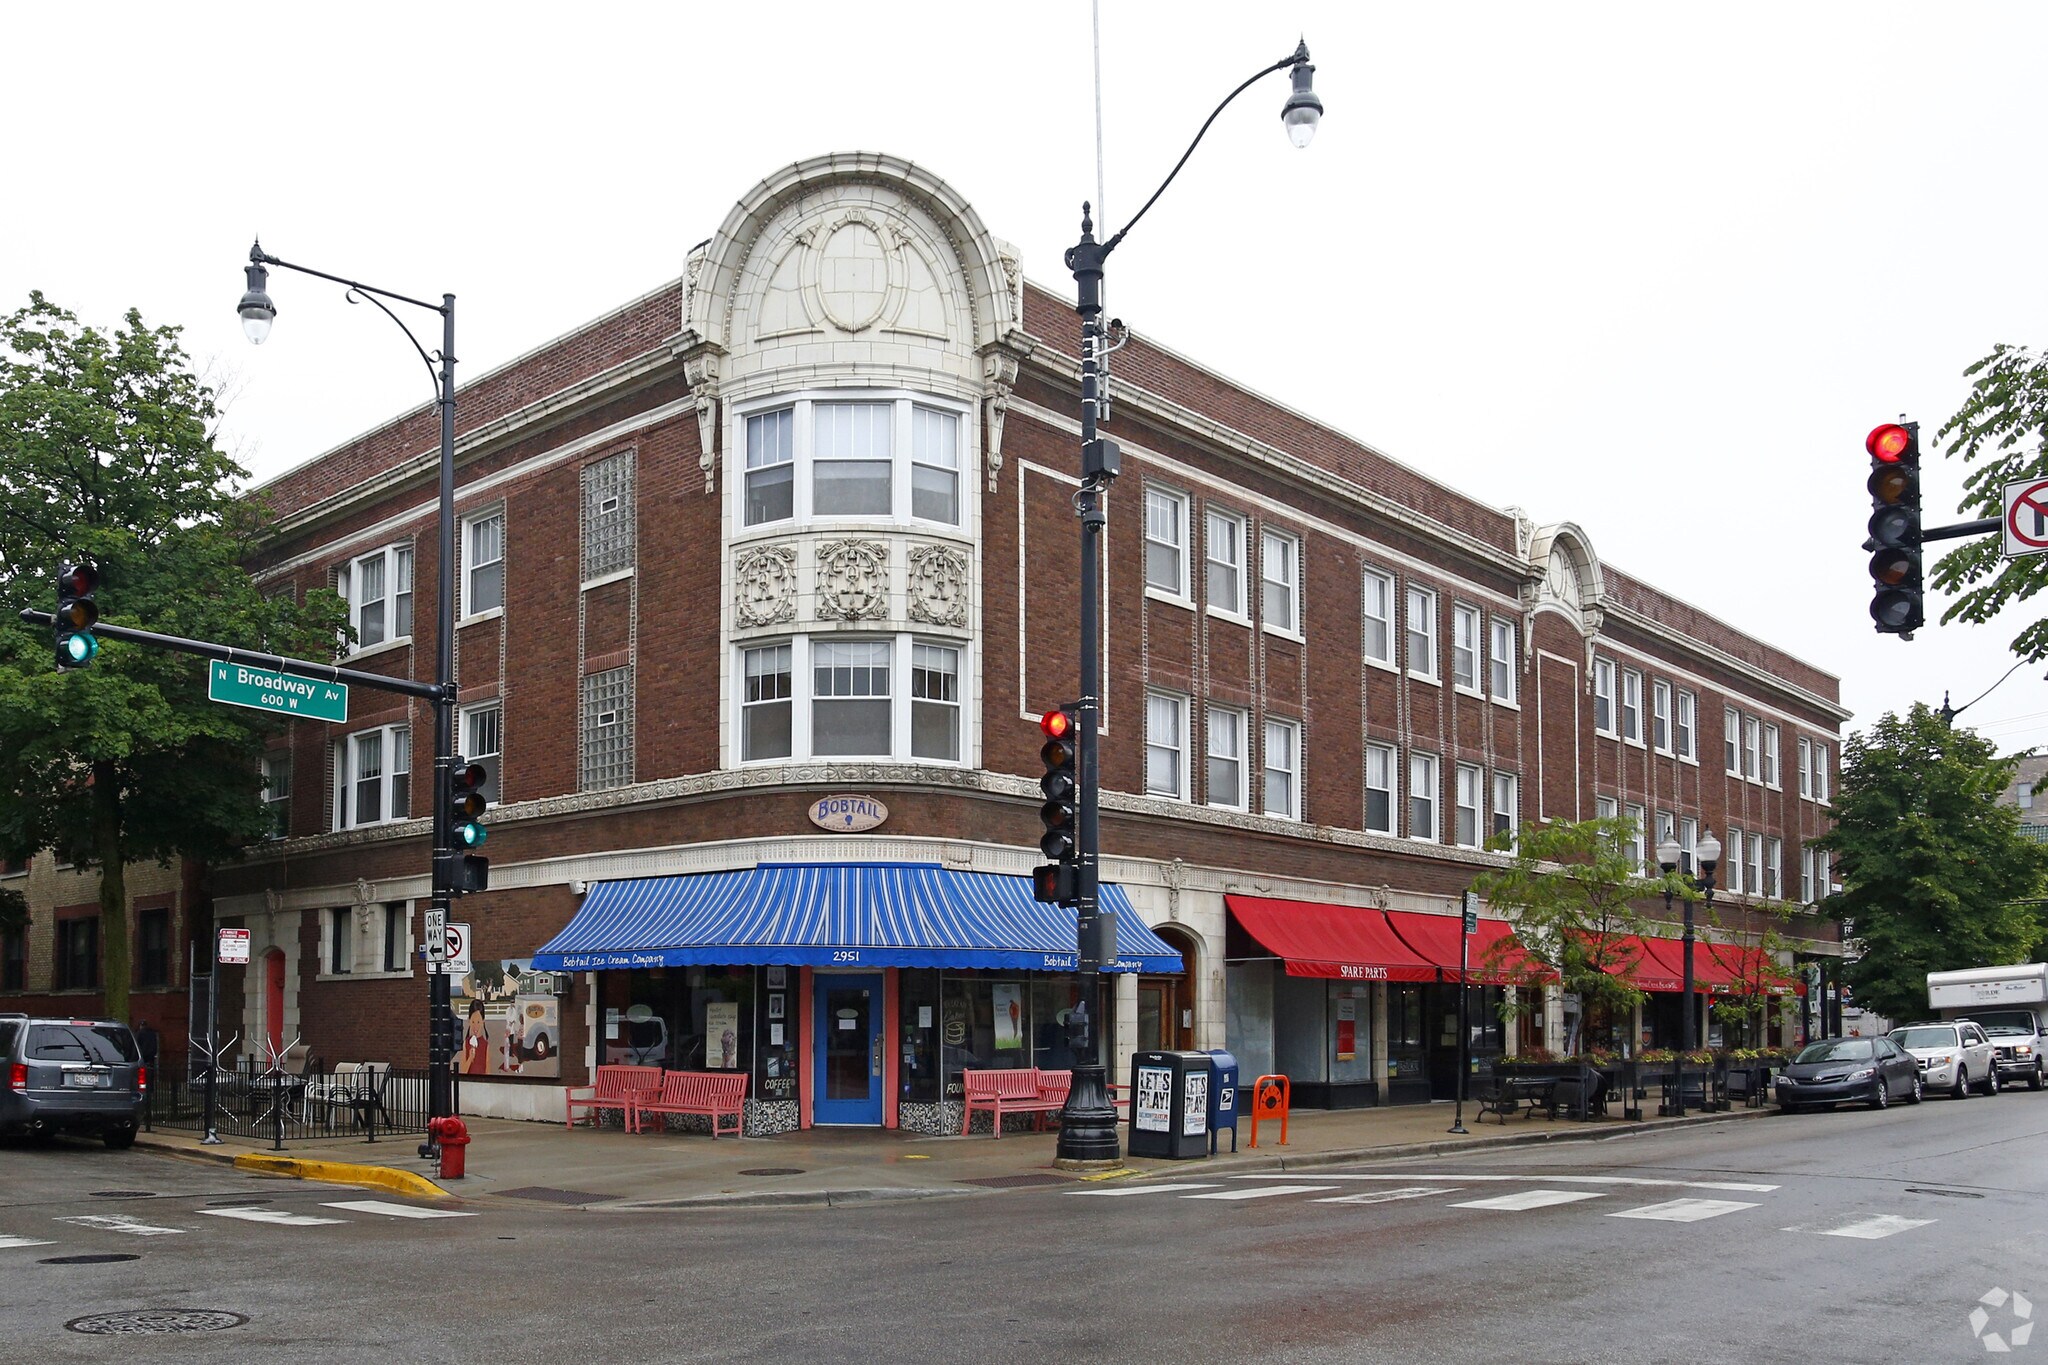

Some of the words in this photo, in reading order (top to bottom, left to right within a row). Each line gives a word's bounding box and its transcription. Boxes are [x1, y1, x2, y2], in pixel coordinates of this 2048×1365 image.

[219, 669, 227, 680] N
[238, 668, 315, 700] Broadway
[325, 689, 339, 701] Av
[261, 693, 284, 707] 600
[289, 697, 298, 709] W
[818, 799, 881, 820] BOBTAIL
[427, 913, 442, 927] ONE
[427, 929, 442, 941] WAY
[563, 956, 590, 967] Bobtail
[592, 956, 605, 966] Ice
[608, 954, 630, 965] Cream
[632, 953, 664, 967] Company
[833, 951, 860, 962] 2951
[1044, 955, 1072, 967] Bobtail
[1114, 960, 1142, 972] ompany
[1340, 965, 1364, 978] SPARE
[1365, 966, 1388, 979] PARTS
[764, 1078, 791, 1090] COFFEE
[946, 1083, 965, 1094] FOUN
[1140, 1071, 1170, 1091] LET'S
[1186, 1077, 1206, 1095] LET'S
[1139, 1091, 1170, 1110] PLAY!
[1186, 1096, 1206, 1114] PLAY!
